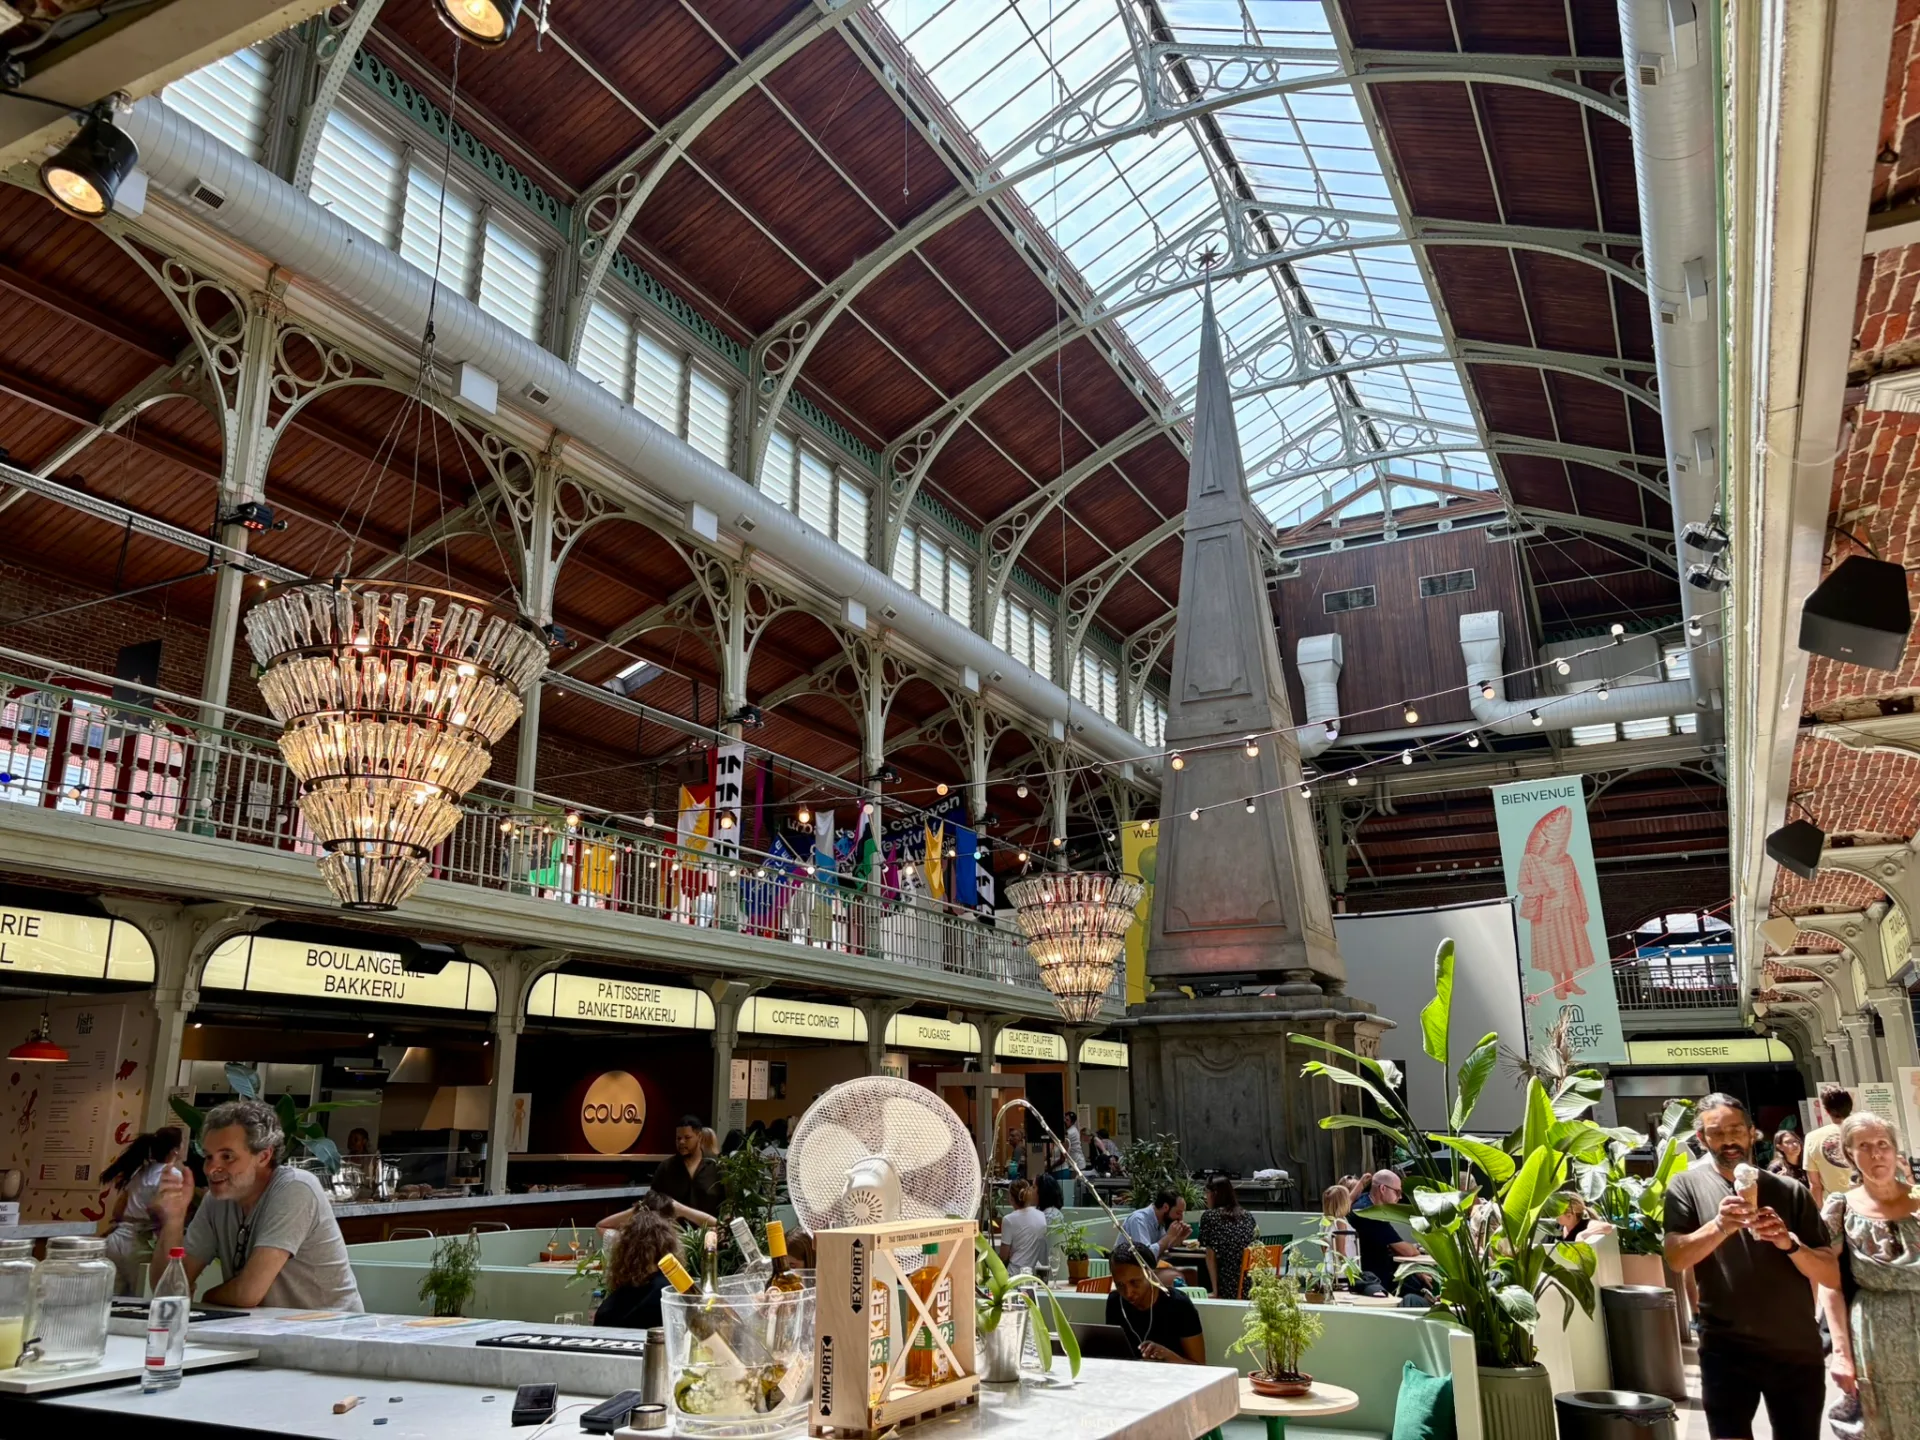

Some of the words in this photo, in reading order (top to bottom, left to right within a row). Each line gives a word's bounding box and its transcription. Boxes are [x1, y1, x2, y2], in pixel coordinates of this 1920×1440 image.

[1501, 787, 1576, 805] BIENVENUE
[306, 949, 425, 979] BOULANGE
[324, 975, 406, 999] BAKKERIJ
[598, 982, 661, 1003] PÂTISSERIE
[578, 1000, 676, 1023] BANKETBAKKERIJ
[772, 1010, 806, 1025] COFFEE
[807, 1014, 839, 1029] CORNER
[919, 1026, 950, 1041] FOUGASSE
[1545, 1023, 1604, 1039] MRCHÉ
[852, 1247, 863, 1304] EXPORT
[821, 1345, 833, 1404] IMPORT
